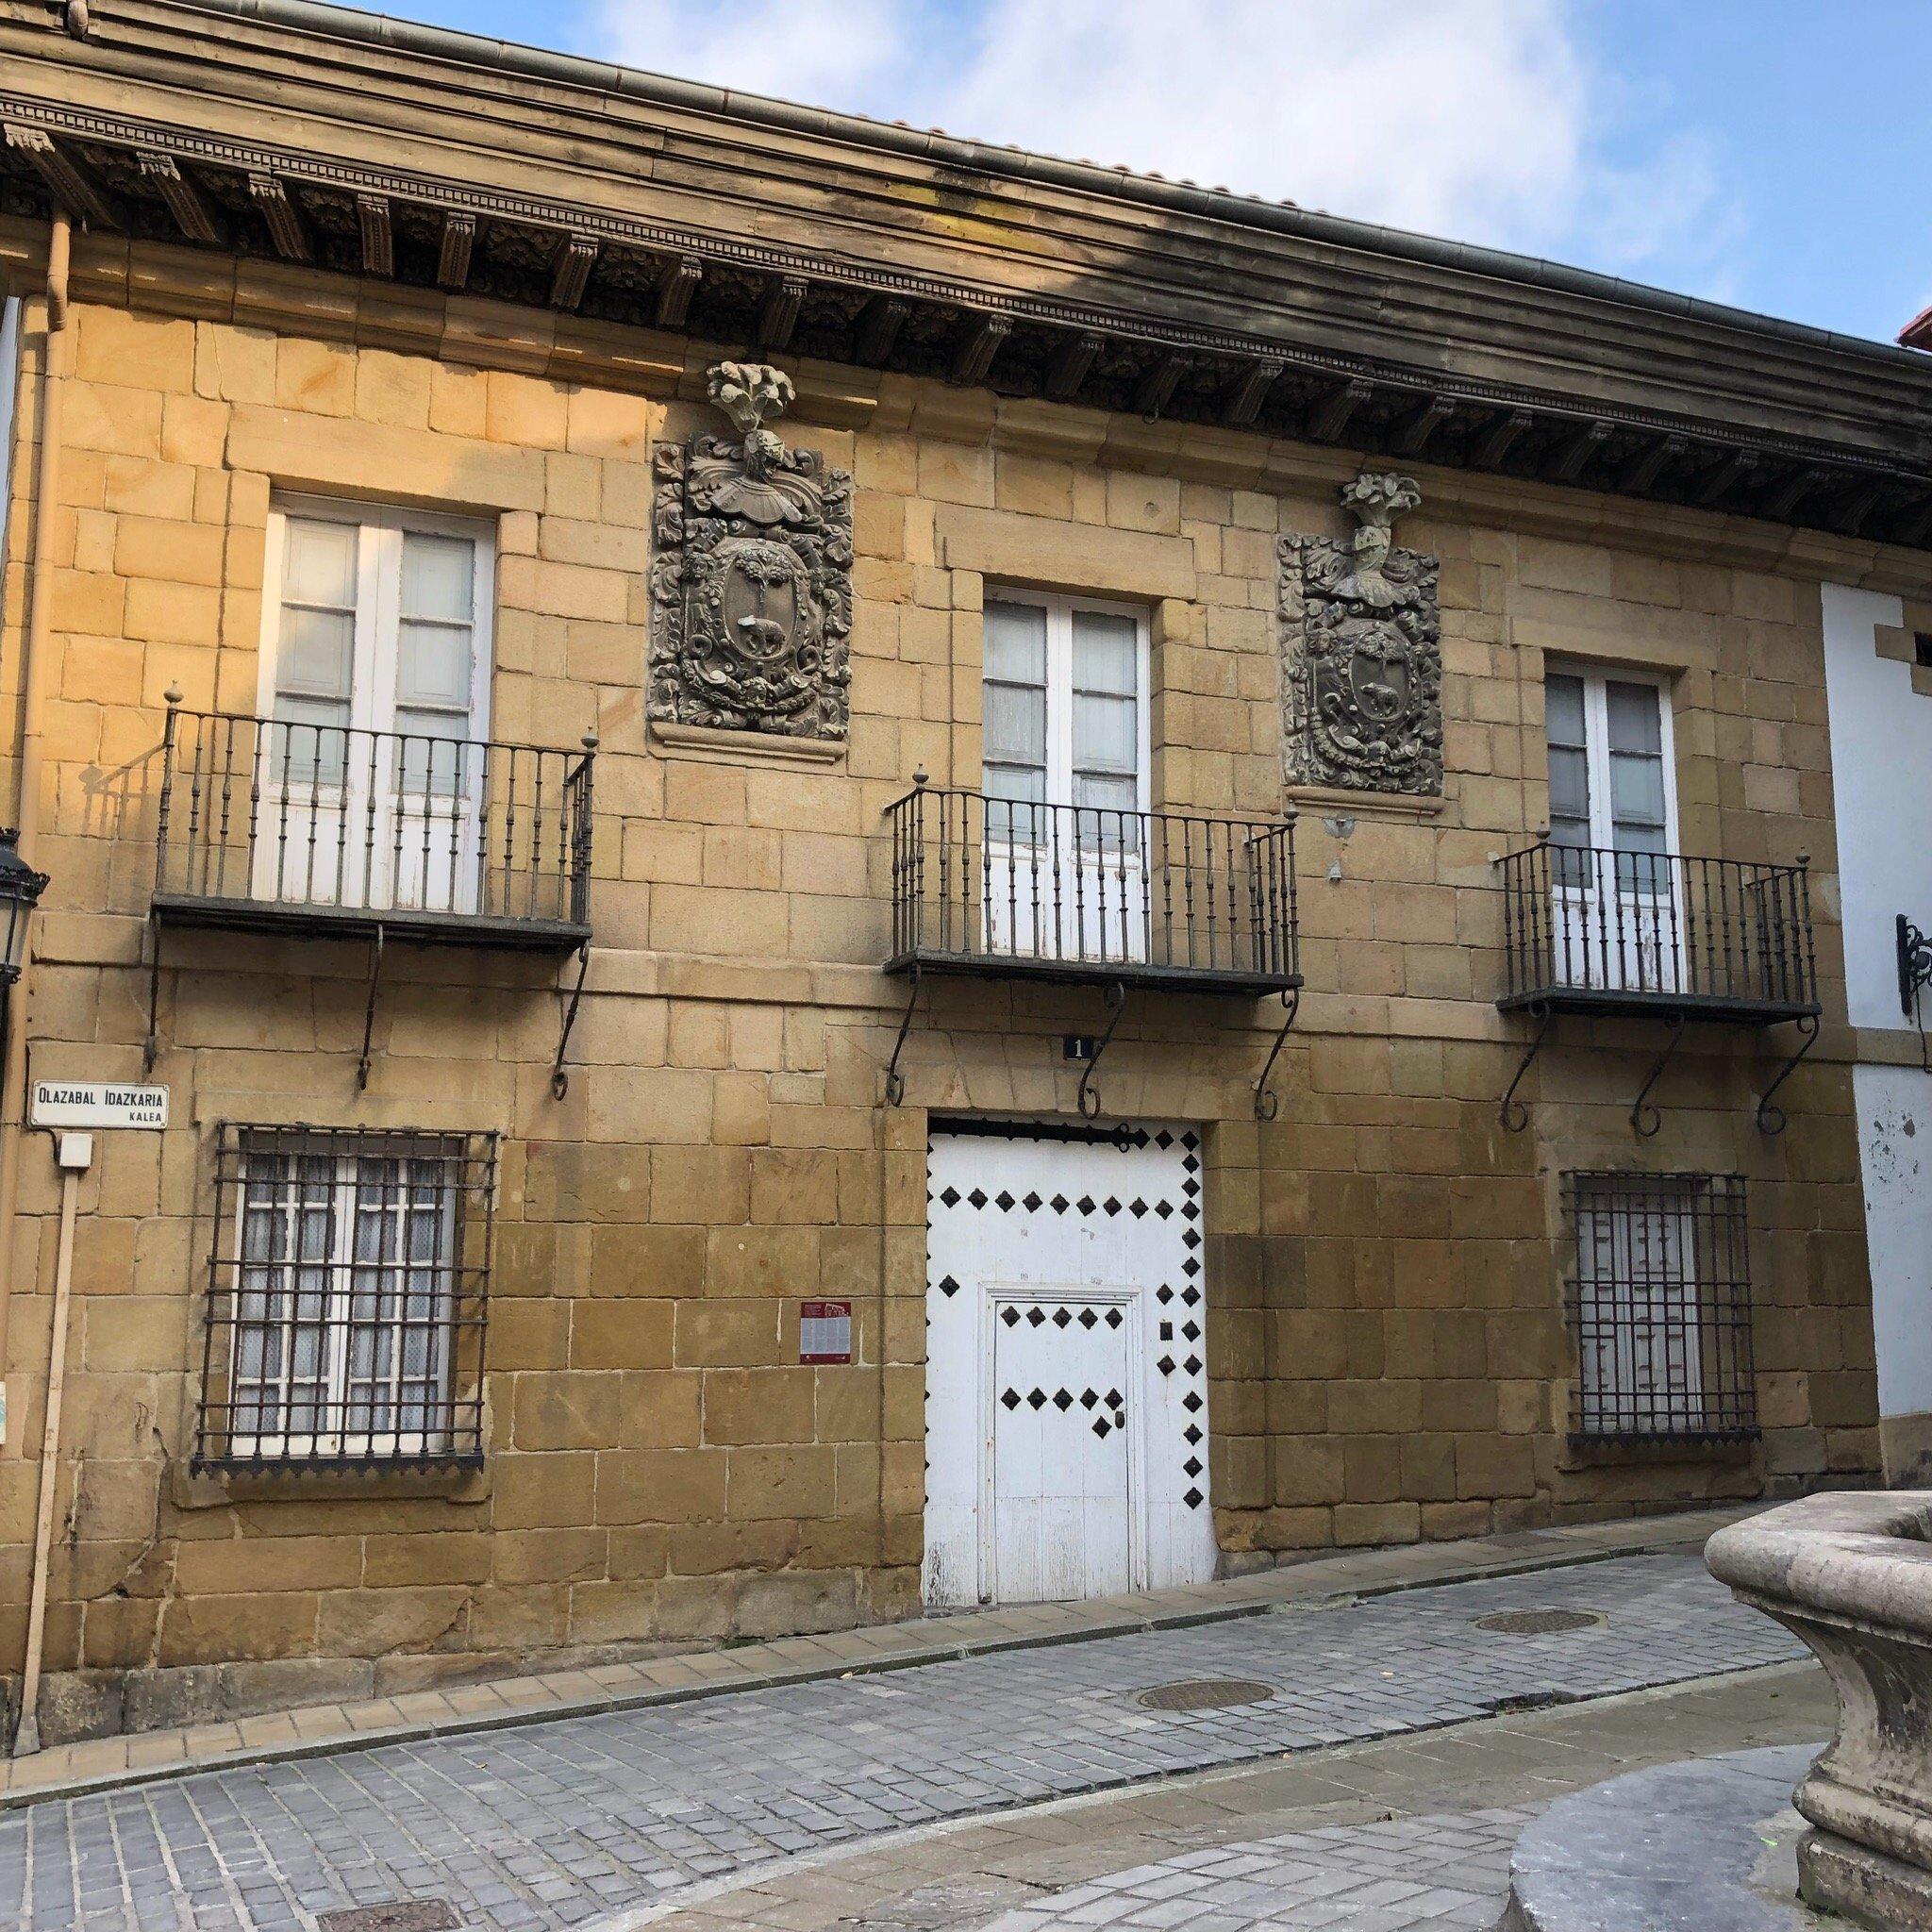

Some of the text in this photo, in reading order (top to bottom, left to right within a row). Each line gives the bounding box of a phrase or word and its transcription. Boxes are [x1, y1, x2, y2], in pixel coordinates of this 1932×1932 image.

[1074, 1040, 1082, 1057] 1
[39, 1087, 162, 1107] OLAZABAL IDAZKARIA
[129, 1112, 161, 1122] KALEA
